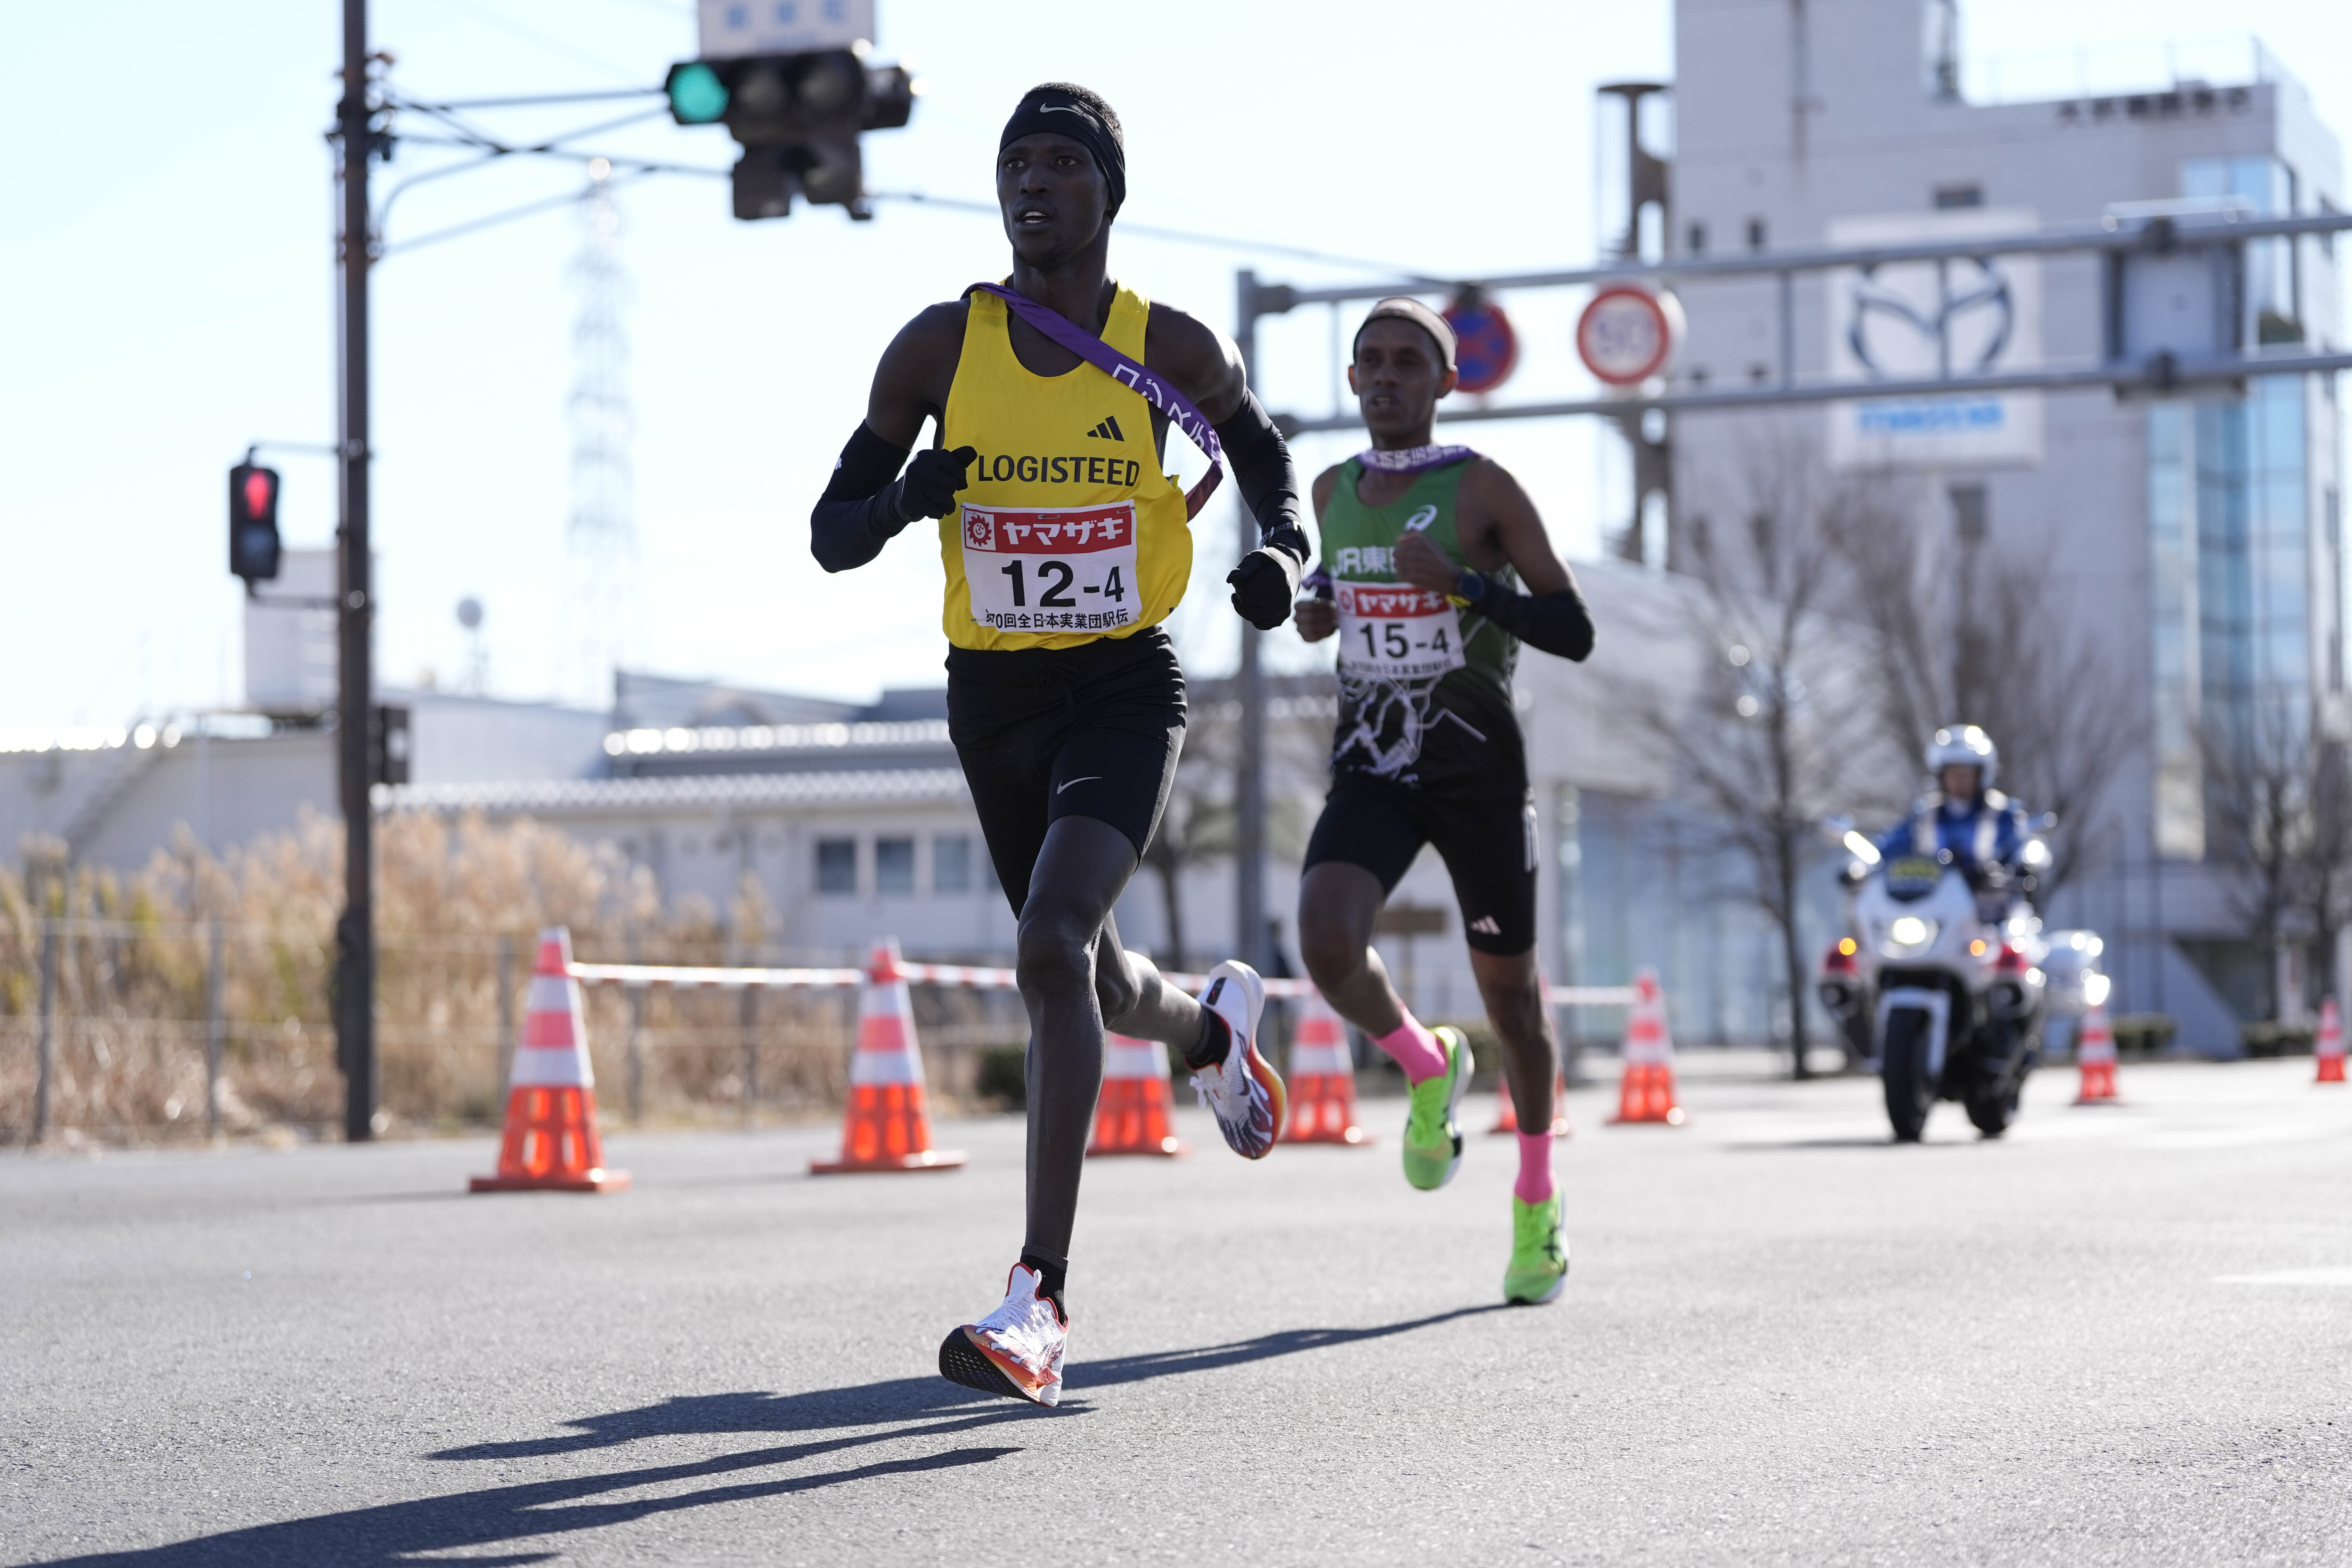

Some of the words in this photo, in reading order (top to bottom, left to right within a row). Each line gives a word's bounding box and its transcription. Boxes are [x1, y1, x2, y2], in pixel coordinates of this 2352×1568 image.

[978, 455, 1140, 486] LOGISTEED
[1003, 517, 1123, 545] ヤマザキ
[1002, 560, 1124, 607] 12-4
[1360, 623, 1450, 658] 15-4
